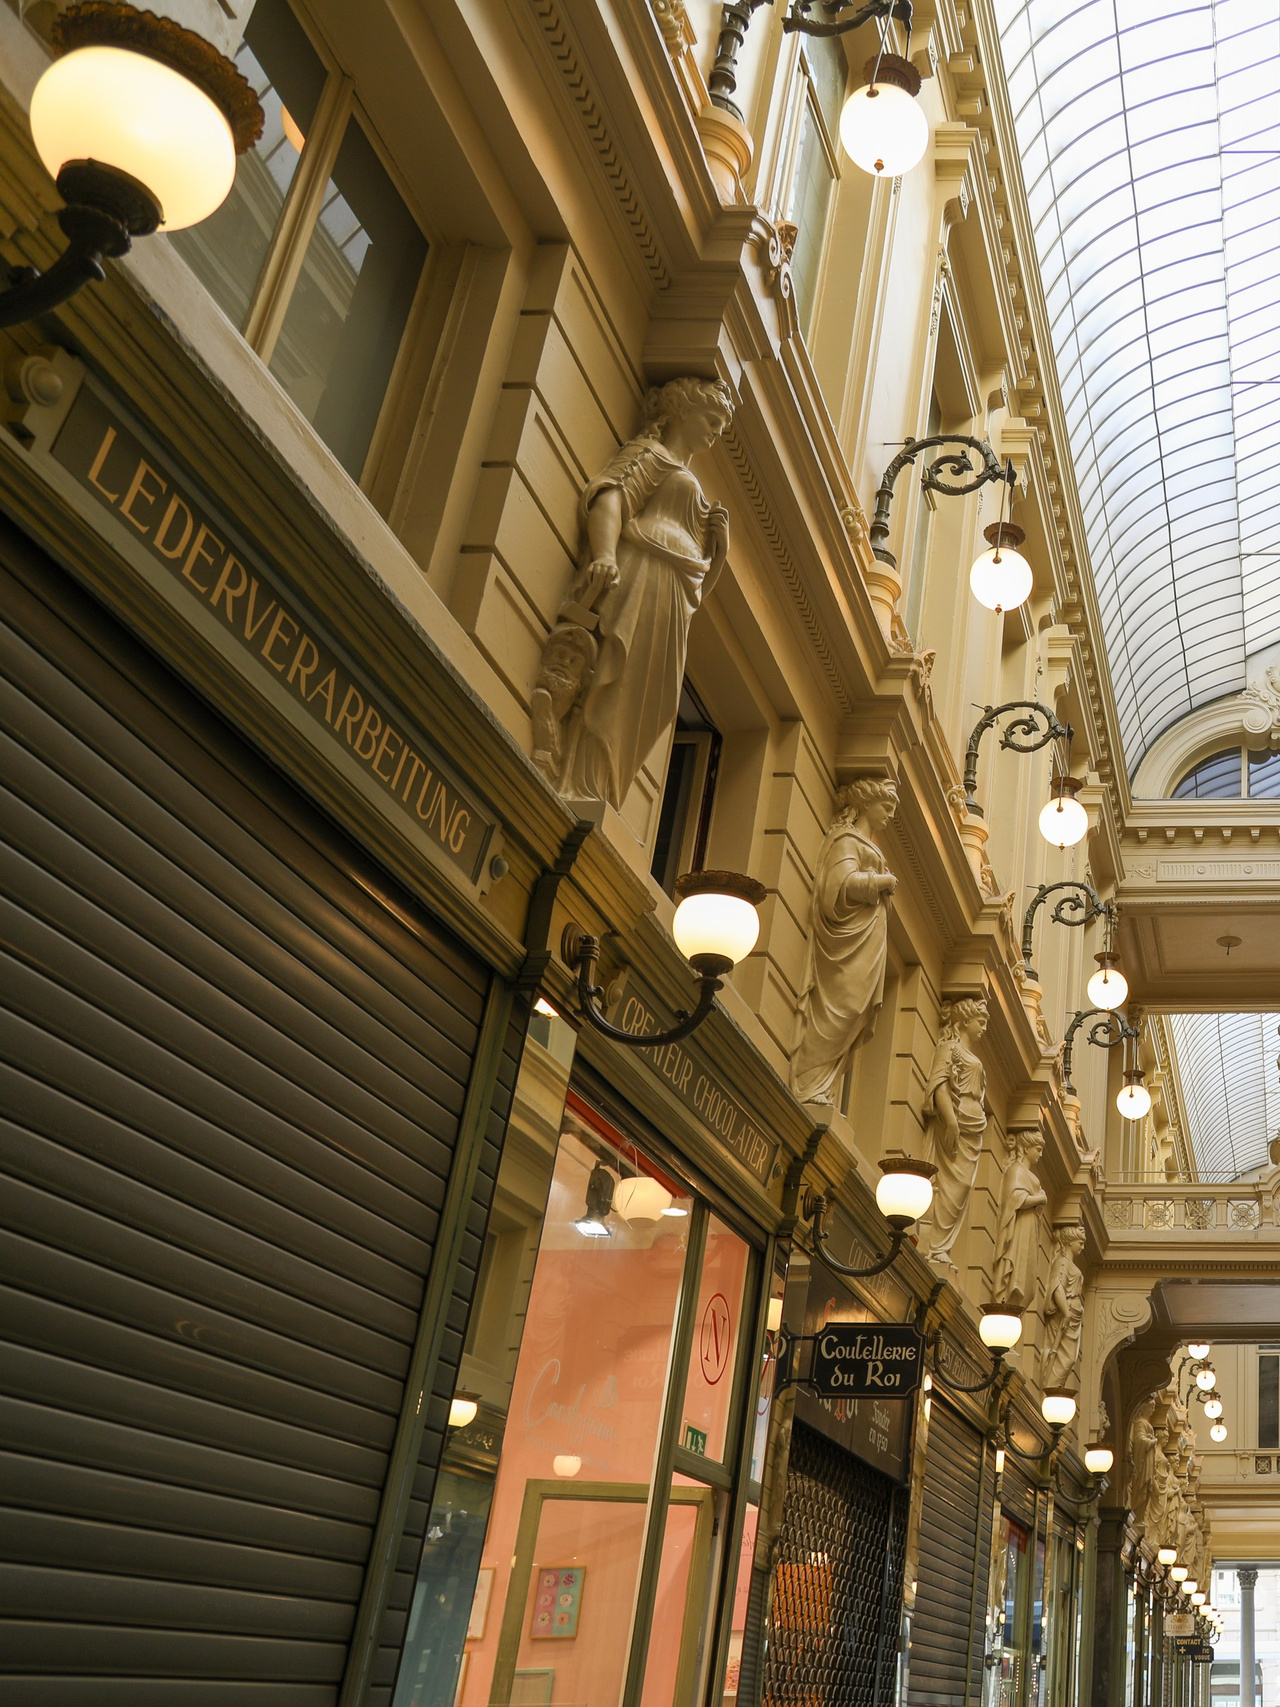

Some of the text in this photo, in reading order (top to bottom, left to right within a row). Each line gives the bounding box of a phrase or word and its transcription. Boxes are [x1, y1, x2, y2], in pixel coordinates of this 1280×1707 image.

[87, 426, 471, 854] LEDERVERARBEITUNG
[693, 1074, 769, 1174] CHOCOLATIER
[820, 1334, 916, 1361] Coutellerie
[830, 1361, 901, 1388] du Roi
